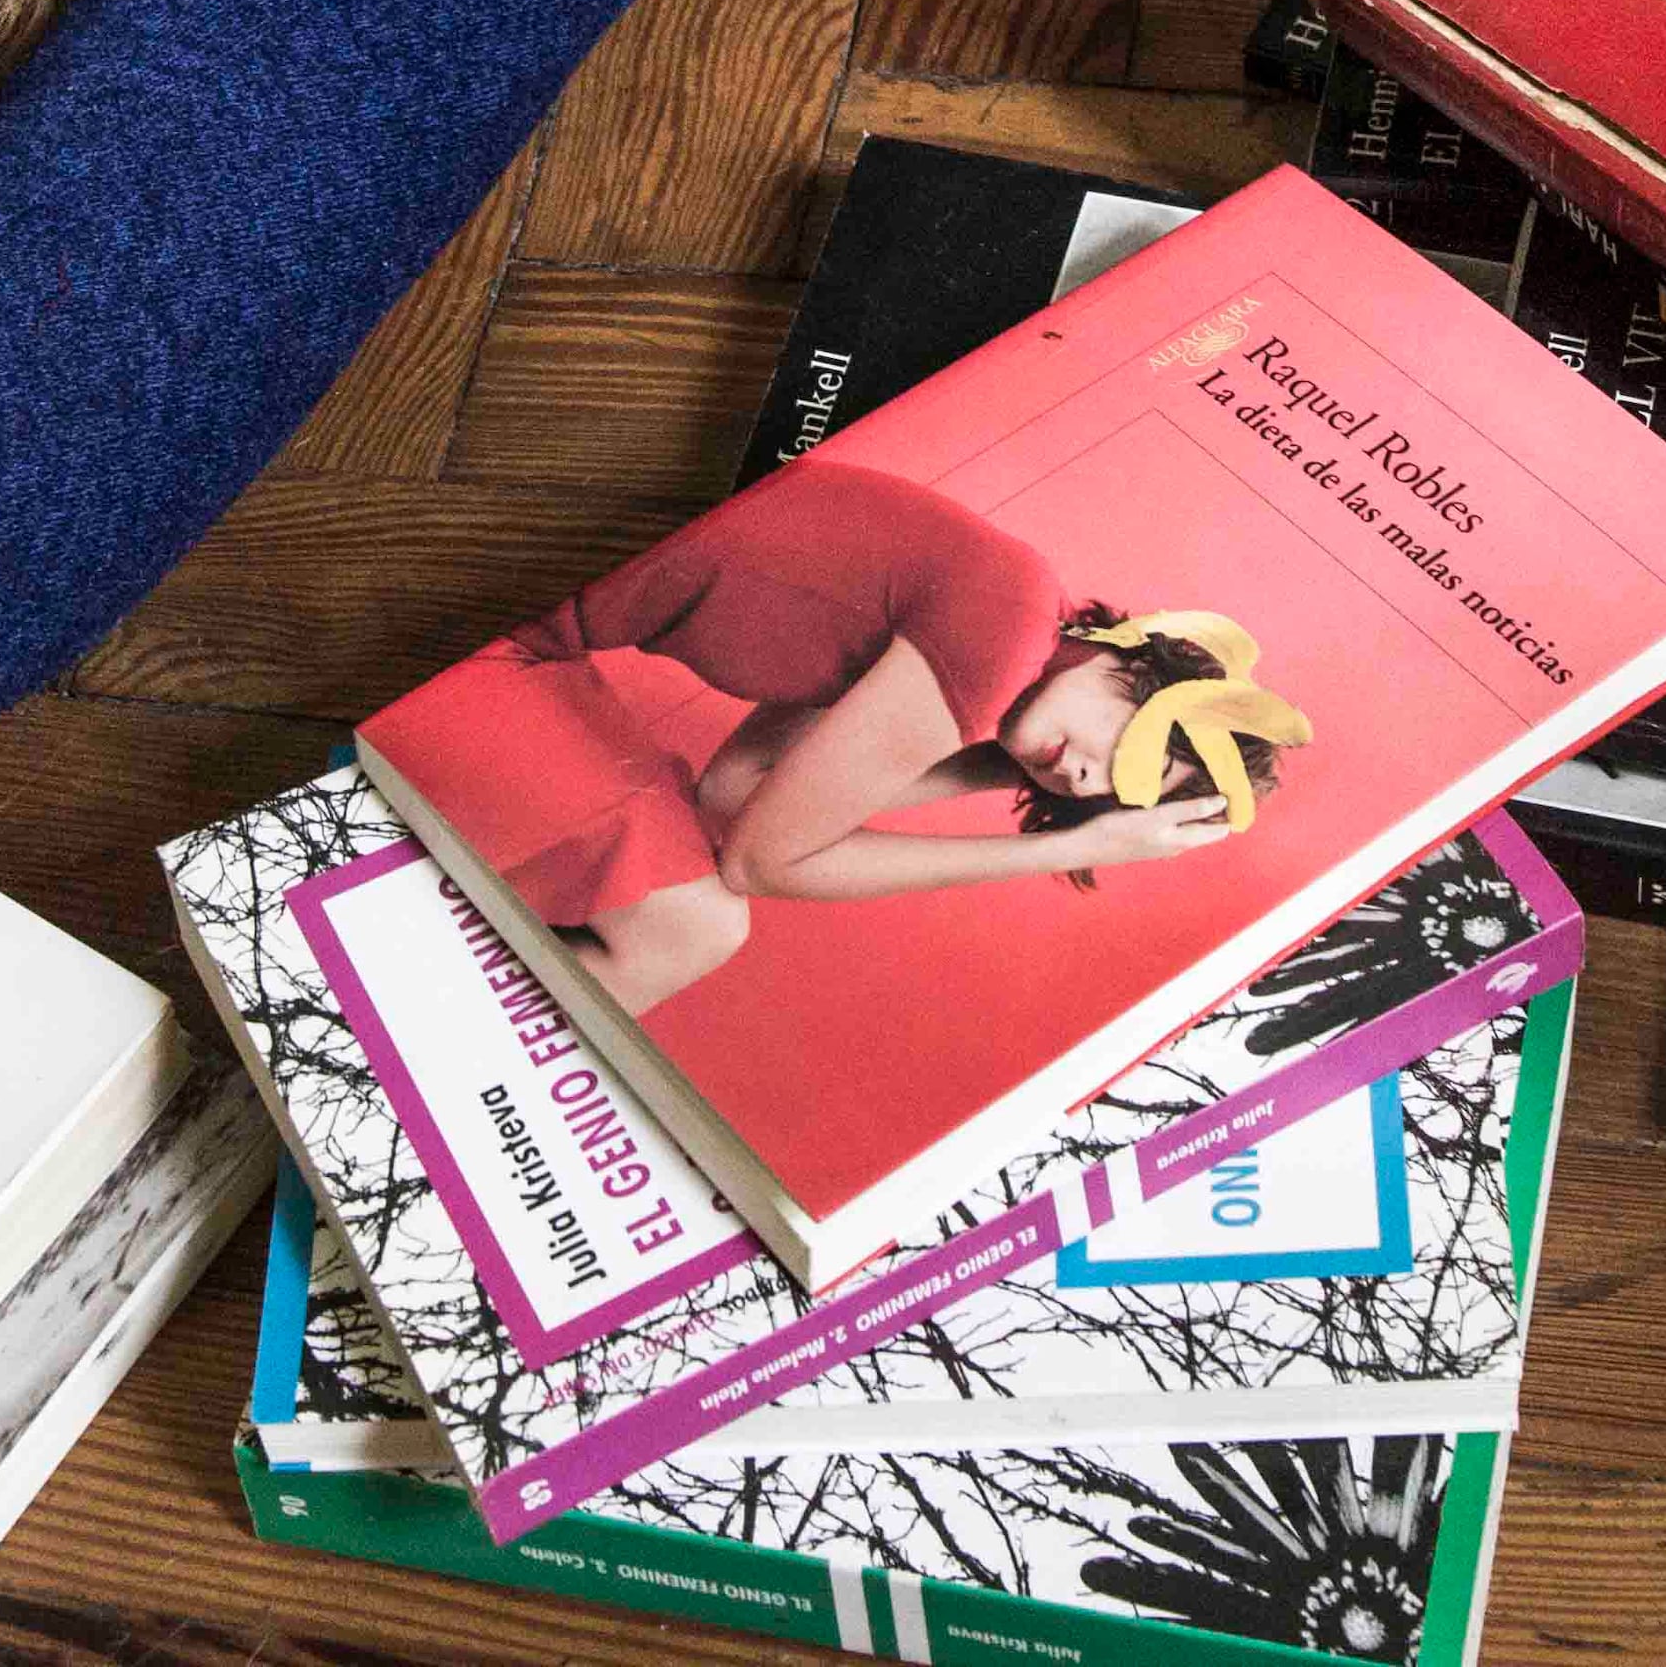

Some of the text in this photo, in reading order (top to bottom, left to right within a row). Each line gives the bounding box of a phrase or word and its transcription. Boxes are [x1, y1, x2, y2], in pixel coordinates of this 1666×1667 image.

[1147, 297, 1264, 372] ALFAGUARA
[1243, 335, 1484, 535] Raquel Robles
[1197, 368, 1575, 686] La dieta de las malas noticias
[550, 1069, 651, 1199] GENIO
[480, 1084, 607, 1289] Julia Kristeva
[626, 1197, 685, 1255] EL
[699, 1099, 1276, 1410] Julia Kristeva EL GENIO FEMENINO 2. Melanie Klein
[520, 1543, 585, 1570] Colette
[618, 1566, 717, 1595] FEMENINO
[723, 1581, 788, 1607] GENIO
[792, 1596, 813, 1612] EL
[946, 1624, 1030, 1653] Kristeva
[1034, 1639, 1082, 1661] Julia
